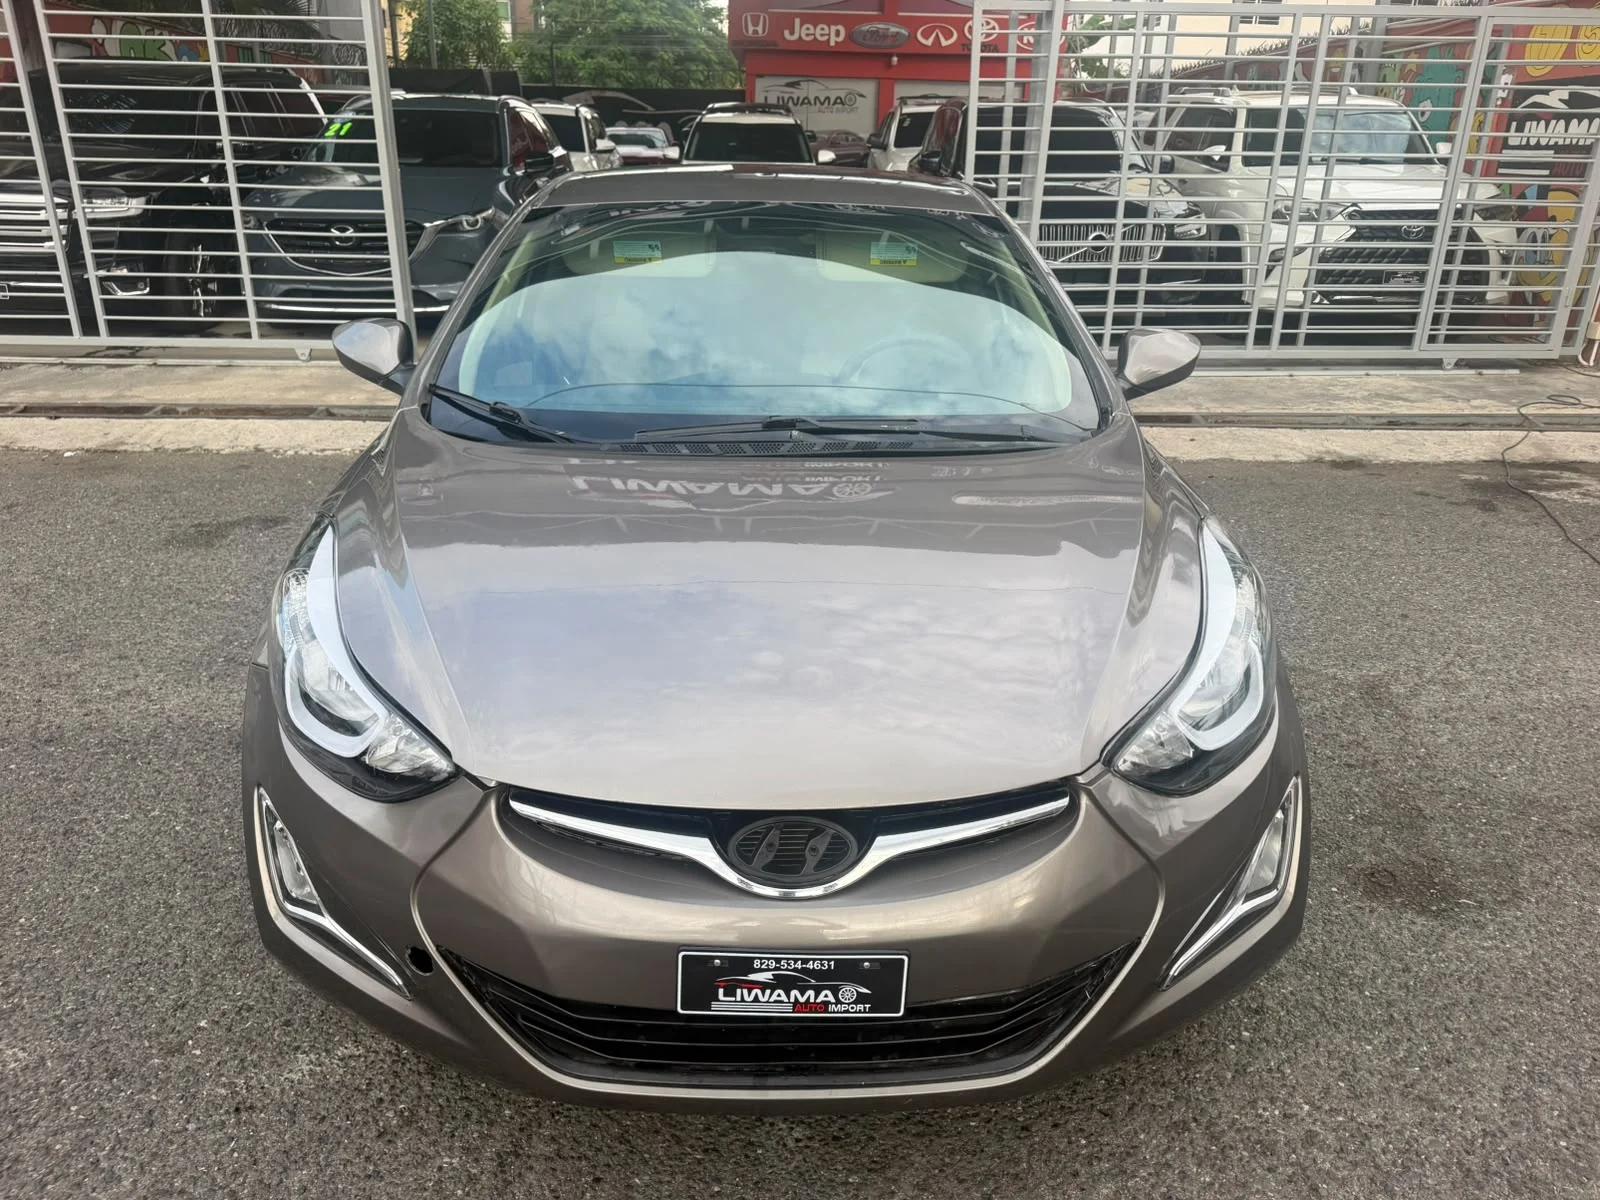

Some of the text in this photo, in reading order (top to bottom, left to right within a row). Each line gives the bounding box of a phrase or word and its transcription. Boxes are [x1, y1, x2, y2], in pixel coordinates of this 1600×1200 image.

[784, 18, 845, 46] Jeep
[960, 43, 999, 53] TOOTA
[324, 122, 353, 136] 21
[753, 959, 835, 970] 829-534-4631
[718, 988, 836, 1003] LIWAMA
[794, 1003, 872, 1013] AUTO IMPORT
